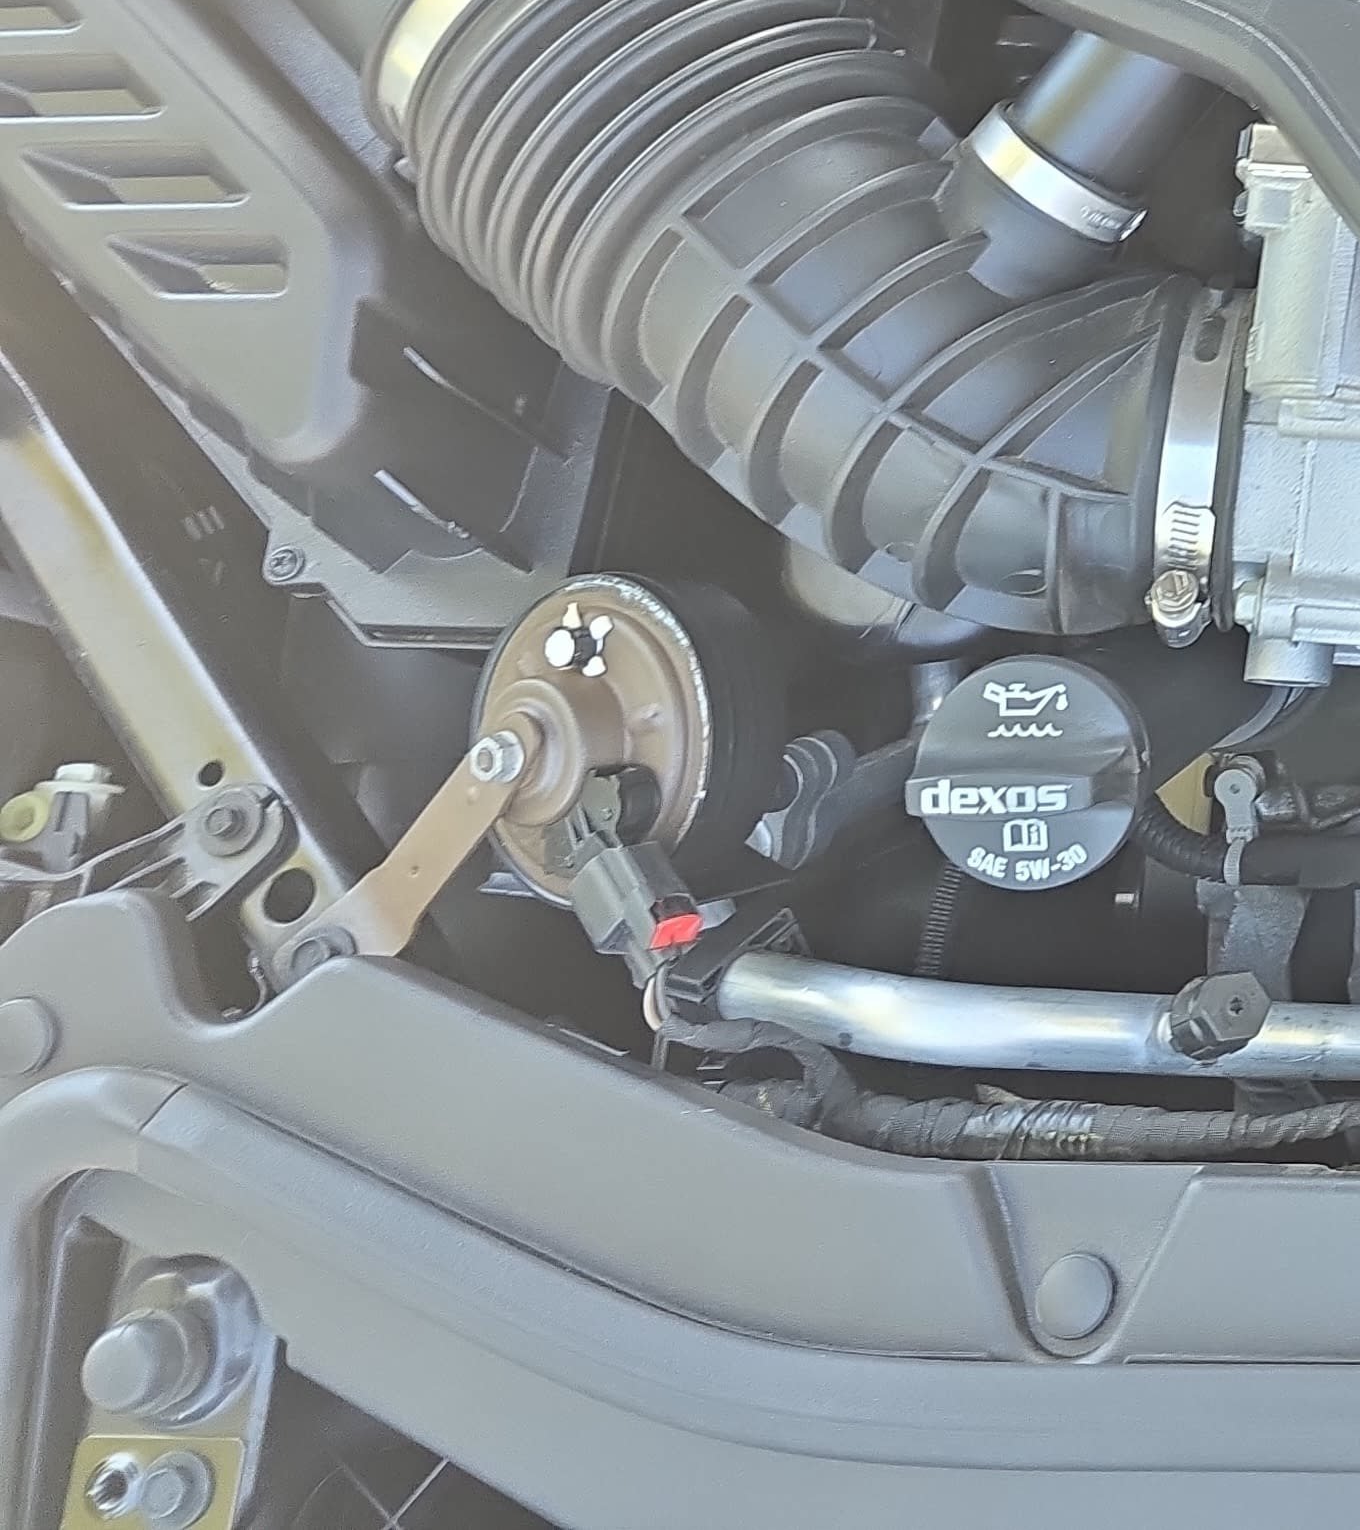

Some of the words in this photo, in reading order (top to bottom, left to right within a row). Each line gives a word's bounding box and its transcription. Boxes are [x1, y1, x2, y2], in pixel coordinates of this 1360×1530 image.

[920, 780, 1071, 815] dexos
[967, 846, 1009, 879] SAE
[1015, 843, 1088, 882] 5W-30
